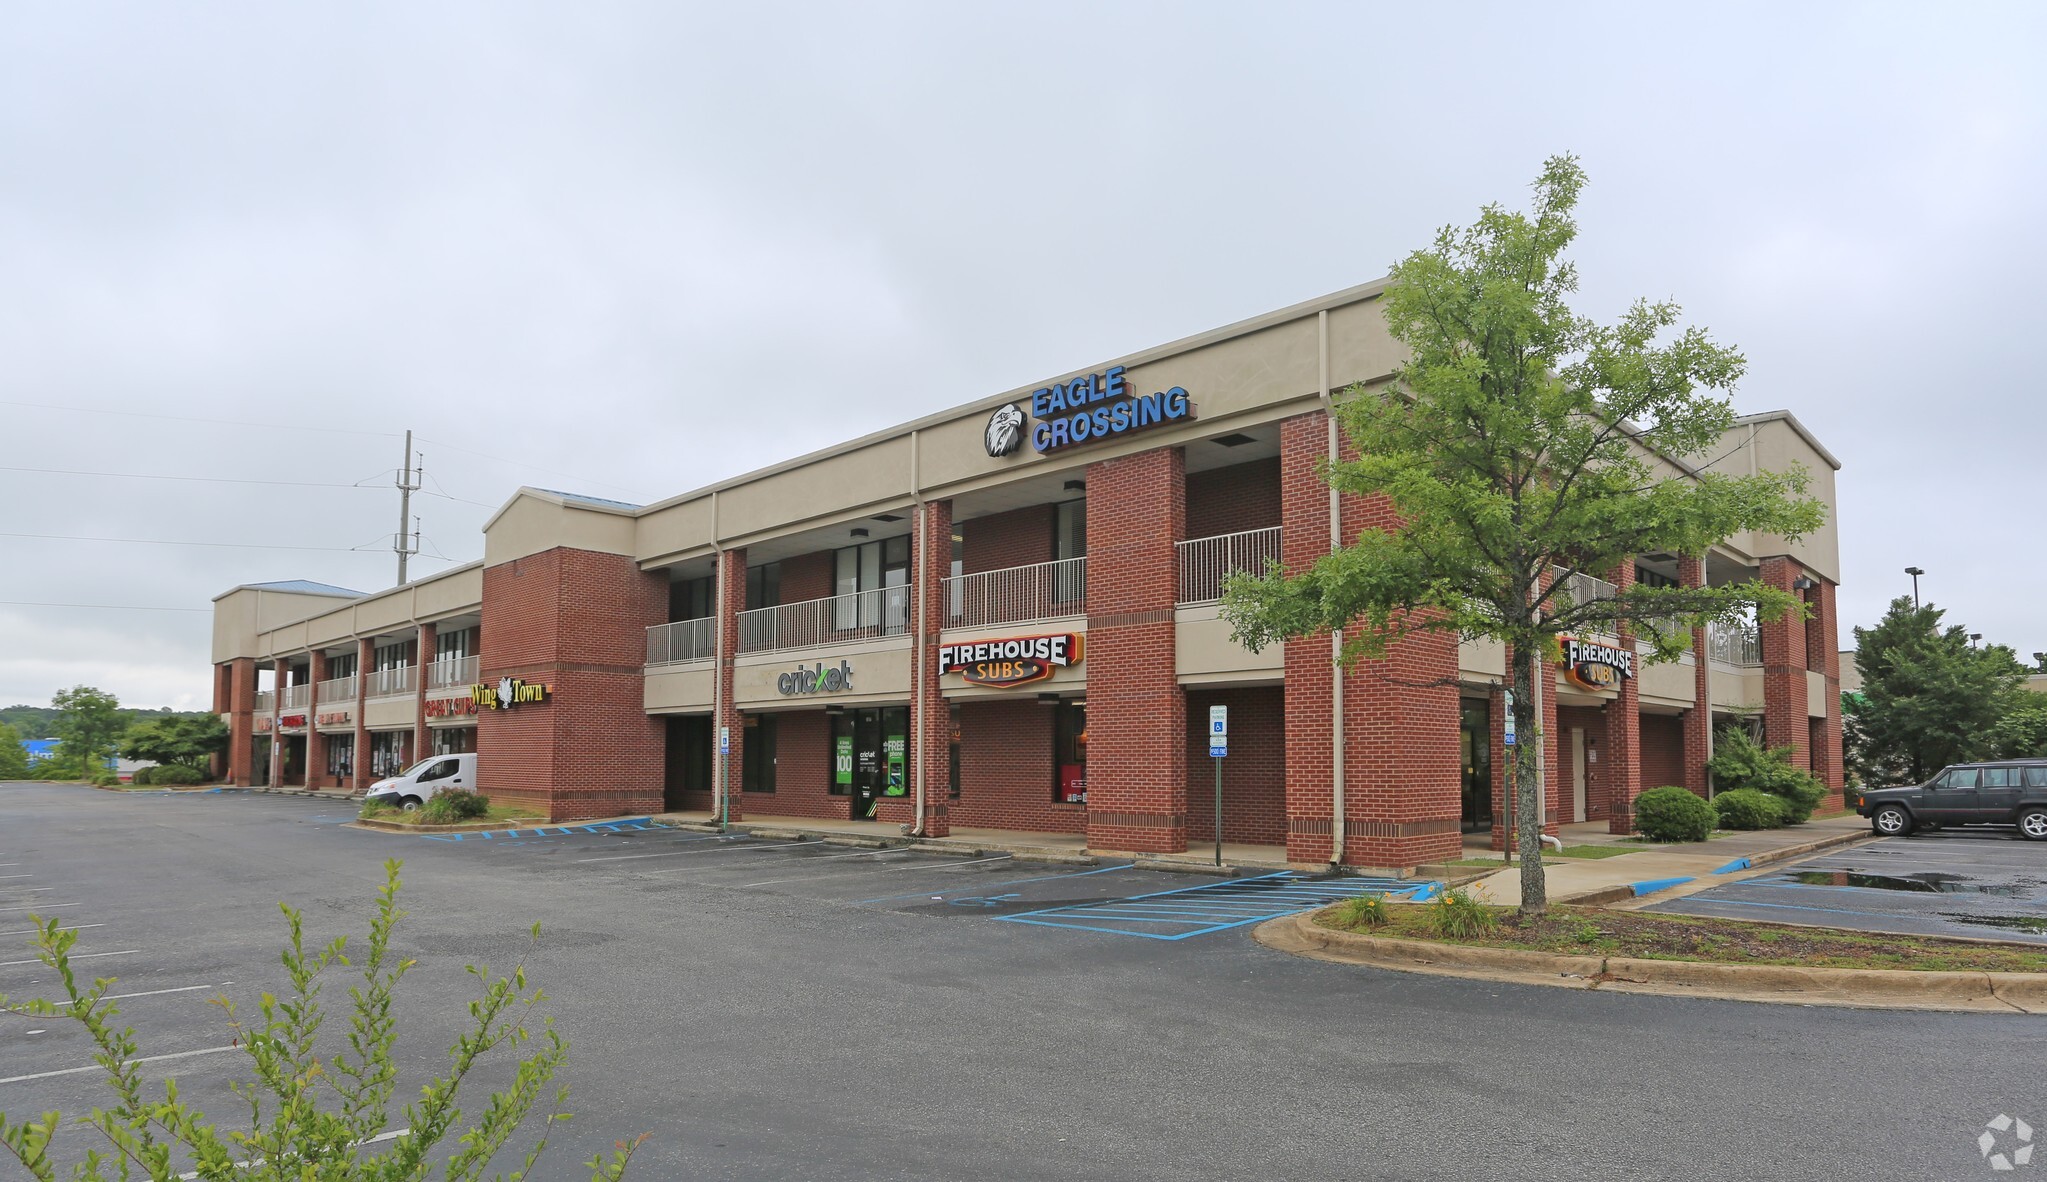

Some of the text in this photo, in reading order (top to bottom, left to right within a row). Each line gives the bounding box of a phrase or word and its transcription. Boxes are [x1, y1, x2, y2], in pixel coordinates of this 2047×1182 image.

[1032, 366, 1126, 418] EAGLE
[1032, 386, 1189, 452] CROSSING
[939, 635, 1067, 675] FIREHOUSE
[977, 661, 1024, 680] SUBS
[1569, 640, 1633, 679] FIREHOUSE
[778, 660, 853, 695] cricket
[1591, 663, 1614, 683] SUBS
[425, 697, 476, 717] GREAT CLIPS
[470, 680, 543, 710] Wing Town
[888, 740, 904, 751] FREE
